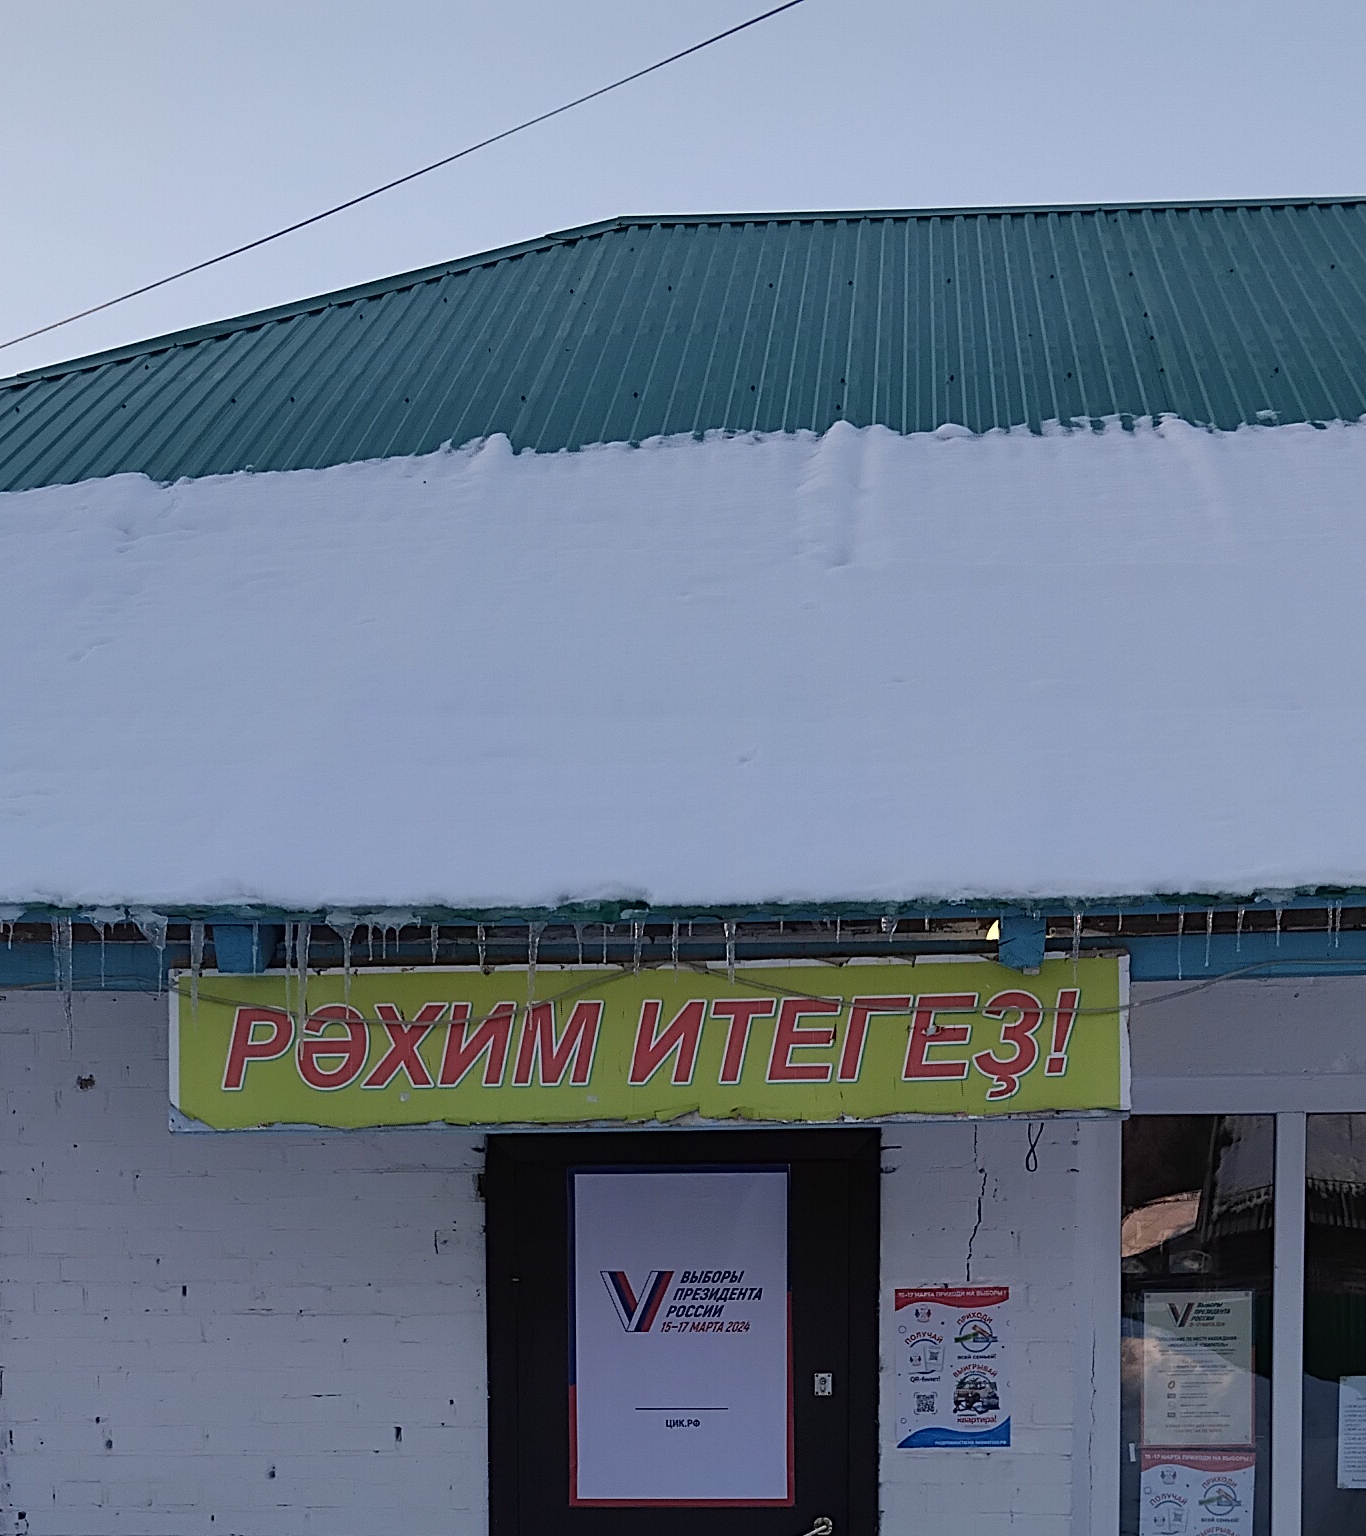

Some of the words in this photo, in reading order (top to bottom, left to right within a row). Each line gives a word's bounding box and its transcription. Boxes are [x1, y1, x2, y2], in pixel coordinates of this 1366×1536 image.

[221, 1000, 605, 1092] РӘХИМ
[628, 987, 1082, 1101] ИТЕГЕҘ!
[679, 1271, 745, 1284] ВЫБОРЫ
[672, 1287, 764, 1303] ПРЕЗИДЕНТА
[665, 1304, 725, 1318] РОССИИ
[956, 1311, 993, 1326] ПРИХОДИ
[690, 1321, 724, 1333] МАРТА
[725, 1320, 751, 1333] 2024
[904, 1331, 944, 1345] ПОЛУЧАЙ
[952, 1363, 998, 1378] ВЫИГРЫВАЙ
[665, 1418, 701, 1430] ЦИК.РФ
[956, 1415, 997, 1424] квартира!
[1201, 1475, 1238, 1489] ПРИХОДИ
[1149, 1491, 1188, 1506] ПОЛУЧАЙ
